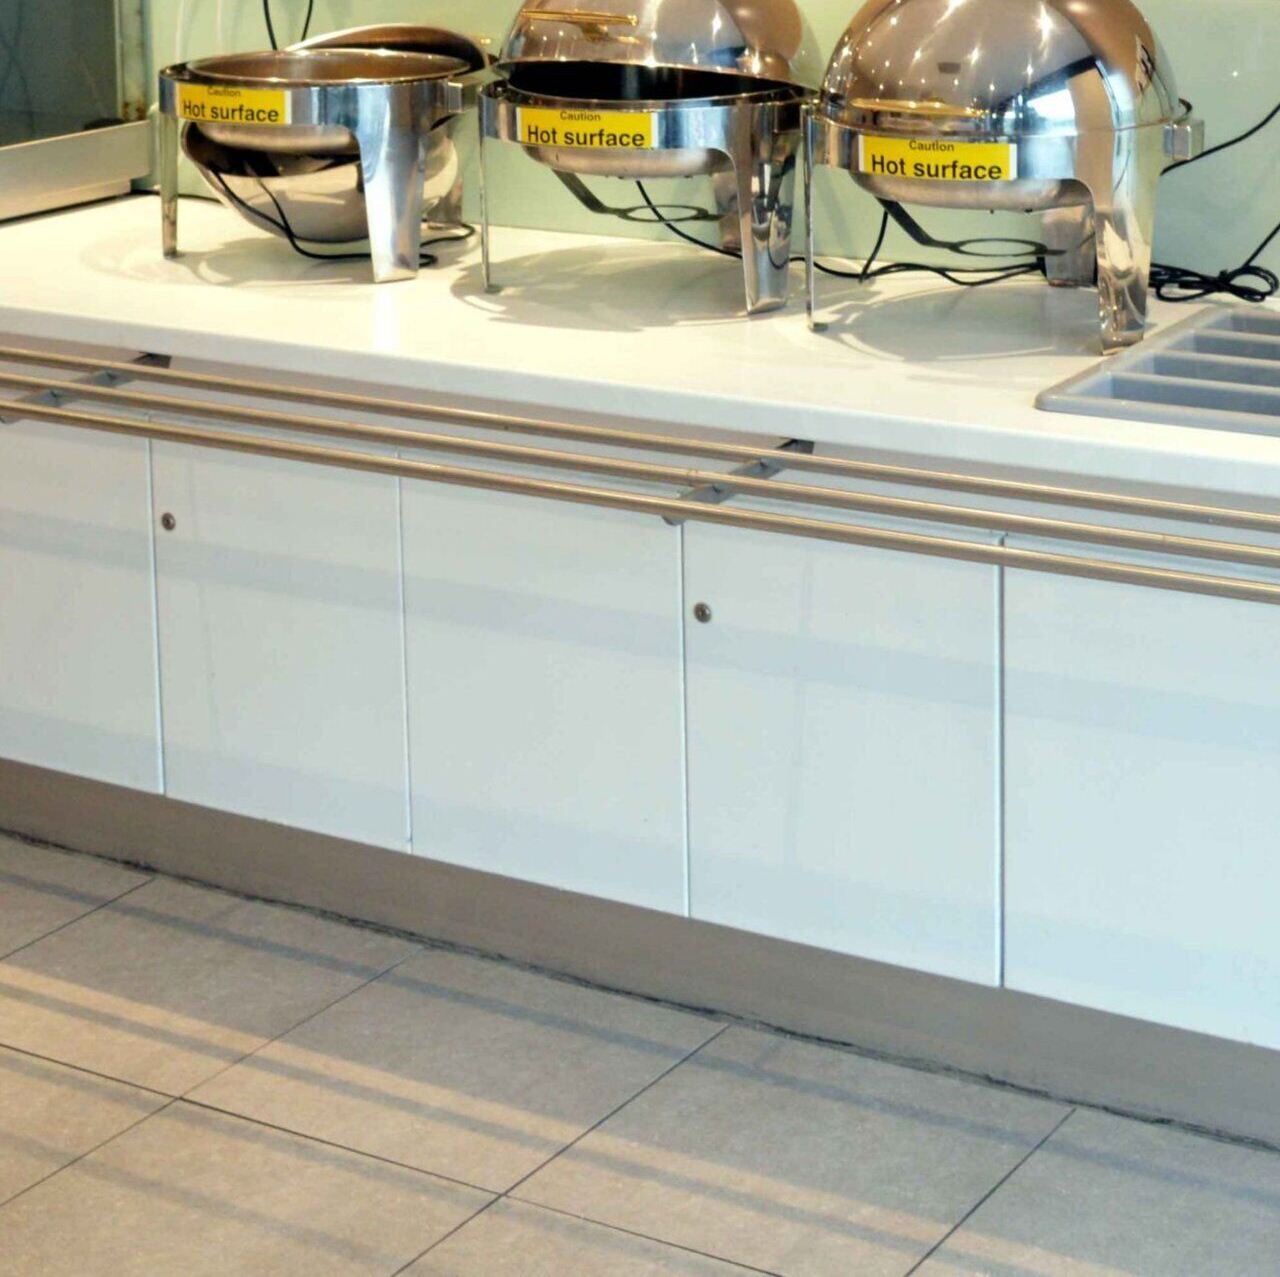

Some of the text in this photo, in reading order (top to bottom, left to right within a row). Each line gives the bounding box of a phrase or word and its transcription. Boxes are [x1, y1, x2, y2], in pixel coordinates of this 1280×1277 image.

[206, 86, 241, 97] Caution
[183, 100, 280, 123] Hot surface
[560, 110, 602, 122] Caution
[527, 125, 645, 147] Hot surface
[908, 140, 955, 152] Caution
[872, 154, 1003, 180] Hot surface
